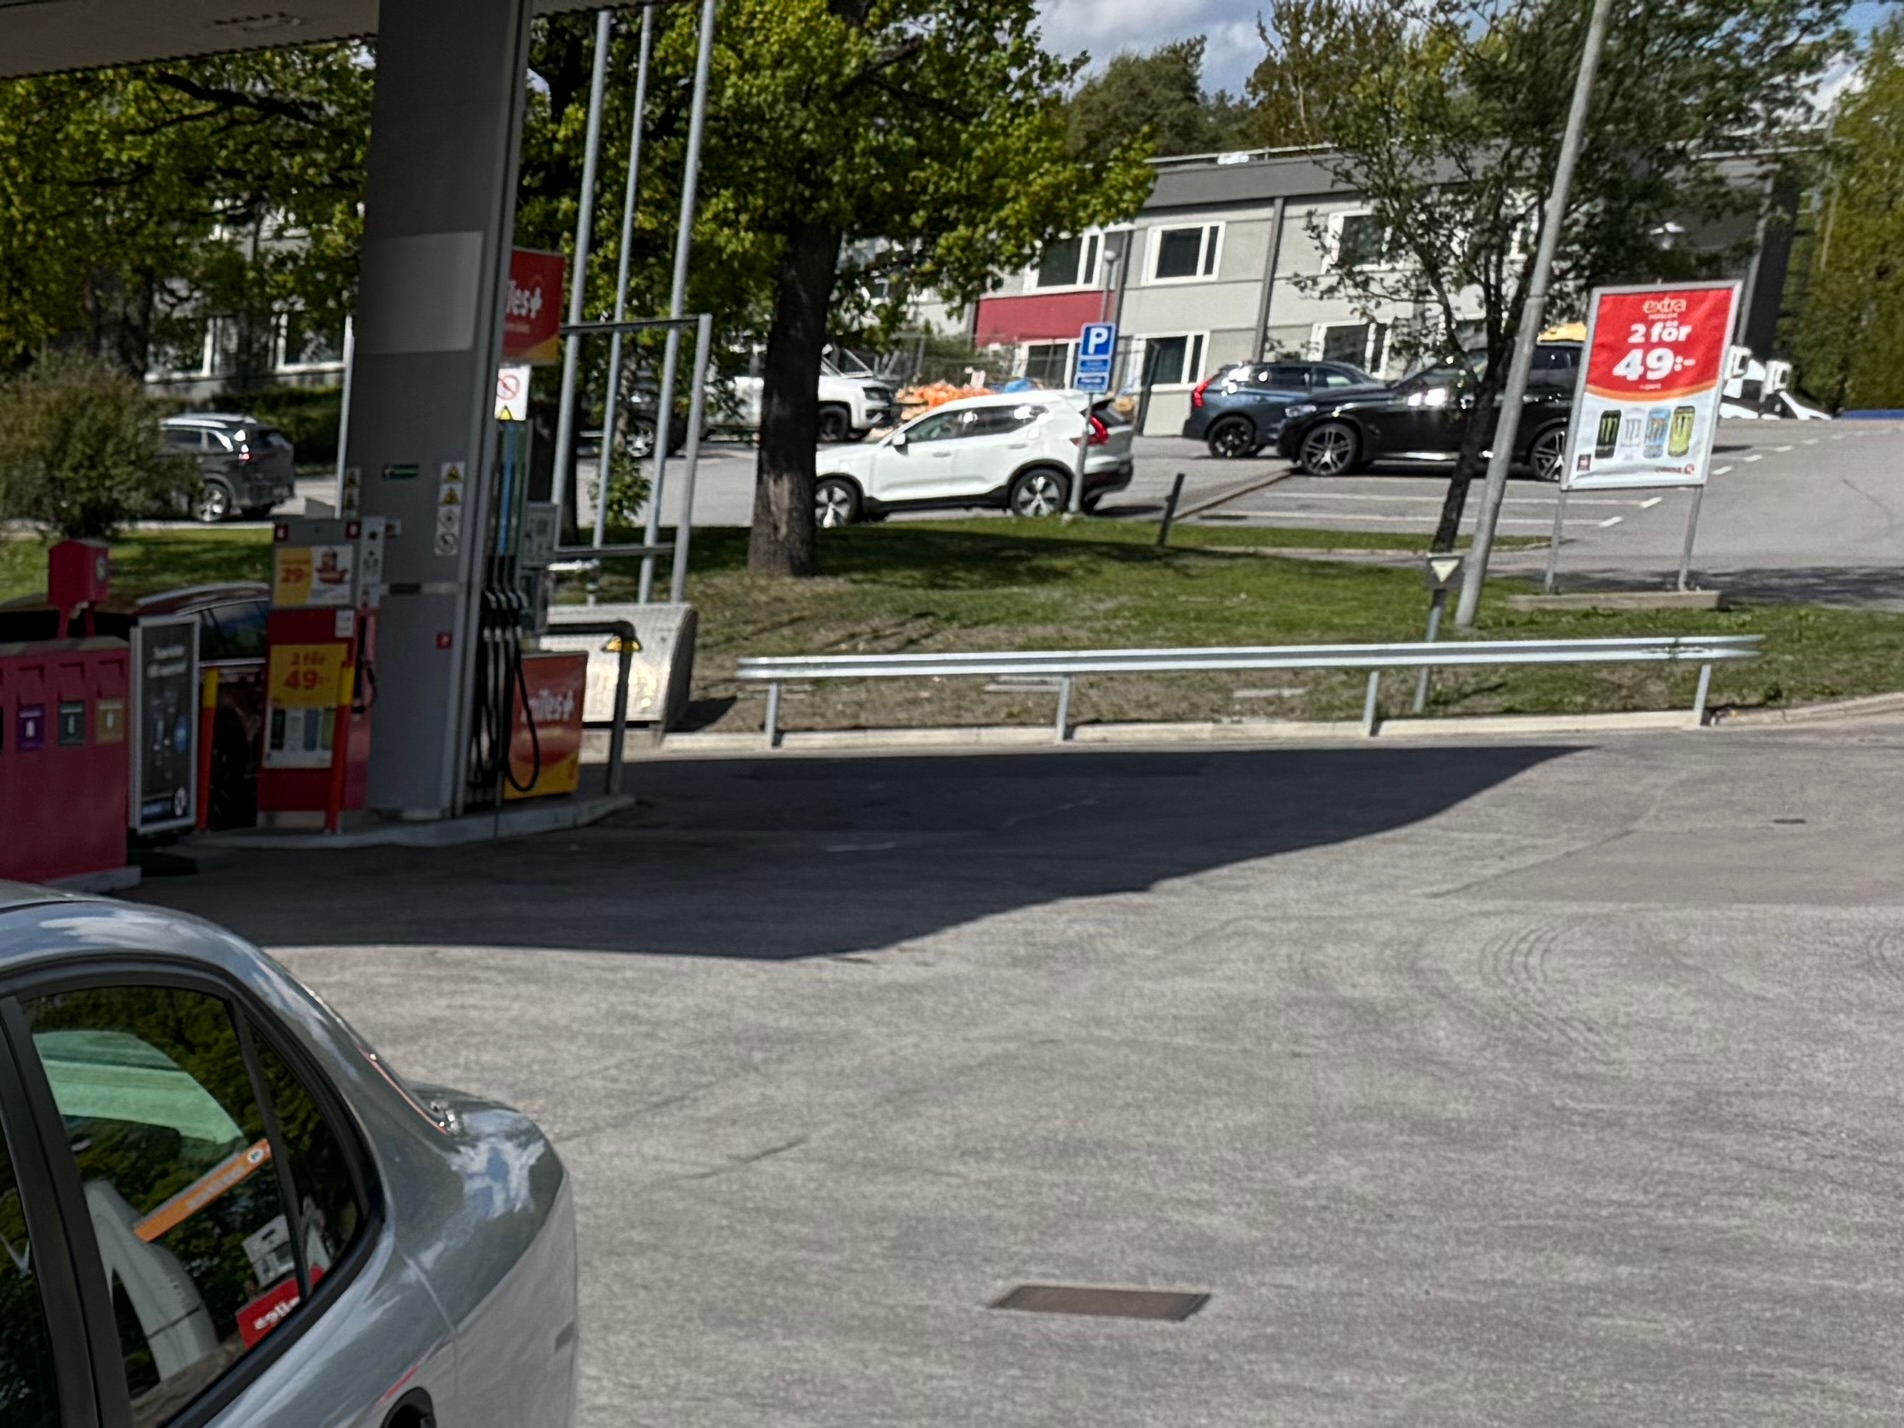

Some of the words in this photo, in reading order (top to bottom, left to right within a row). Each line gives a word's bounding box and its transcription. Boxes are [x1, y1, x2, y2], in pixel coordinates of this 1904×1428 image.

[1628, 323, 1647, 343] 2
[1650, 320, 1692, 343] för
[1612, 347, 1696, 381] 49:-
